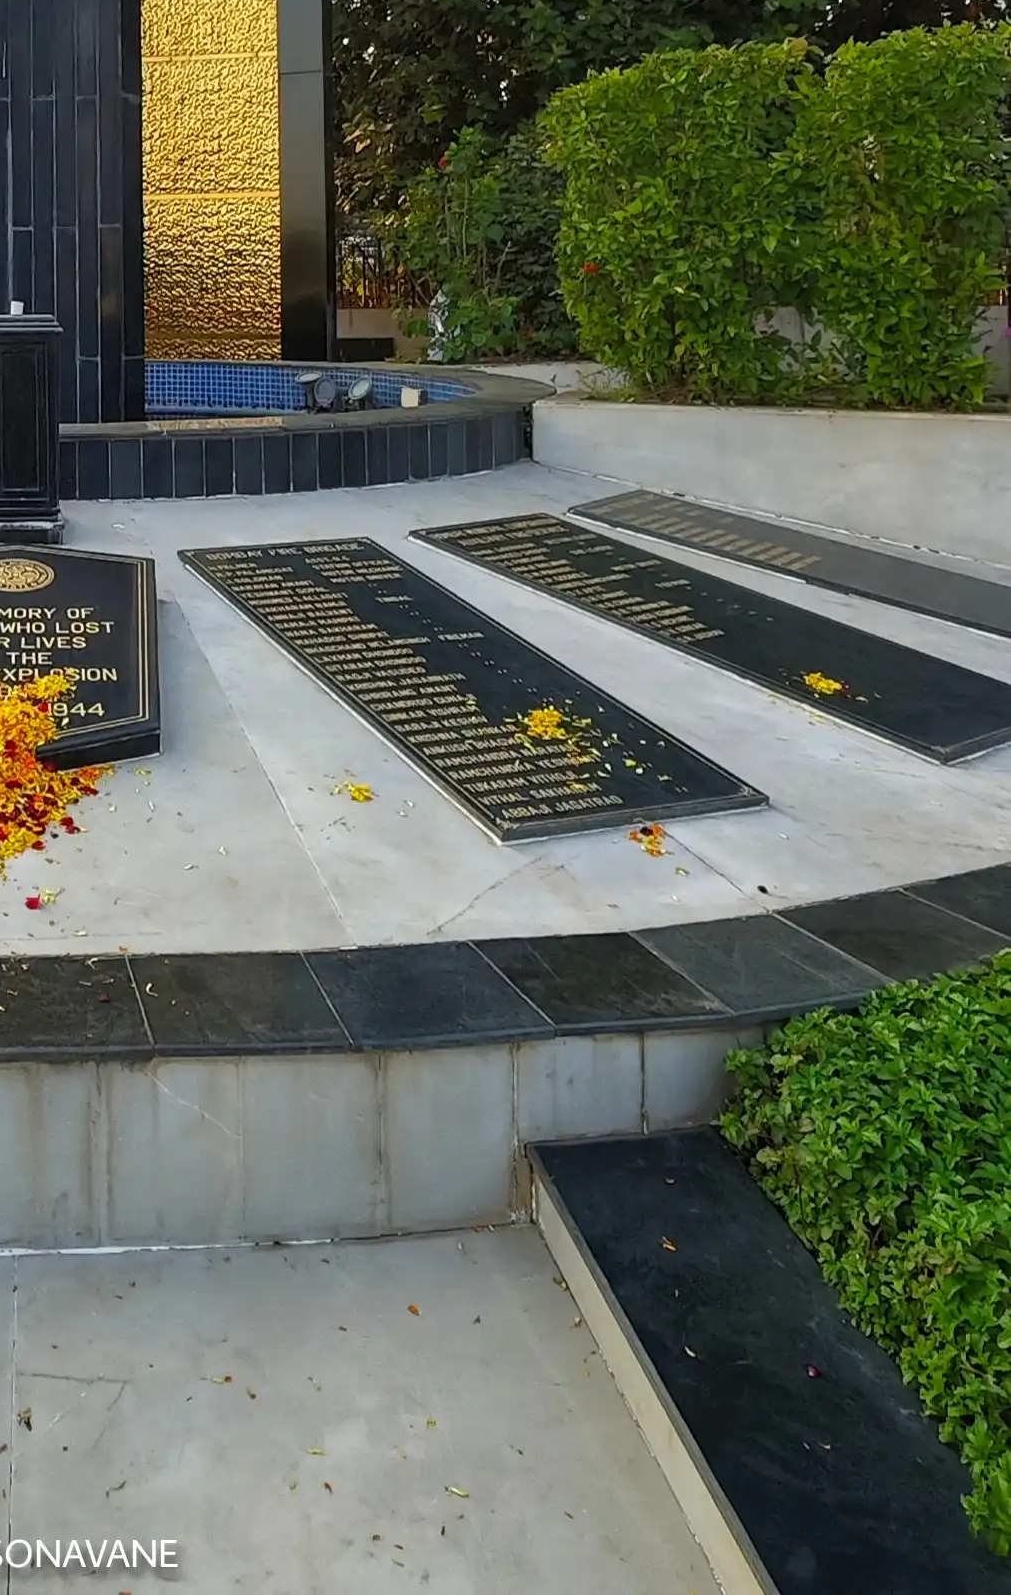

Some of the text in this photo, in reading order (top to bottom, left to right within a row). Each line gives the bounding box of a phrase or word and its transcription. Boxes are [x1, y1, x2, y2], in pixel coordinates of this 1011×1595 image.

[206, 542, 364, 561] BOMBAY FIRE BRIGADE
[329, 575, 364, 583] MOTOR
[67, 608, 95, 618] OF
[0, 622, 45, 633] WHO
[56, 622, 115, 633] LOST
[438, 631, 484, 641] FIREMAN
[21, 637, 87, 648] LIVES
[6, 652, 53, 664] THE
[47, 702, 105, 717] 1944
[407, 731, 460, 743] KRISHNA
[434, 750, 521, 766] RAMCHANDRA
[449, 762, 536, 779] RAMCHANDRA
[464, 778, 529, 792] TUKARAM
[479, 792, 530, 805] VITHAL
[499, 804, 552, 818] ABBAJI
